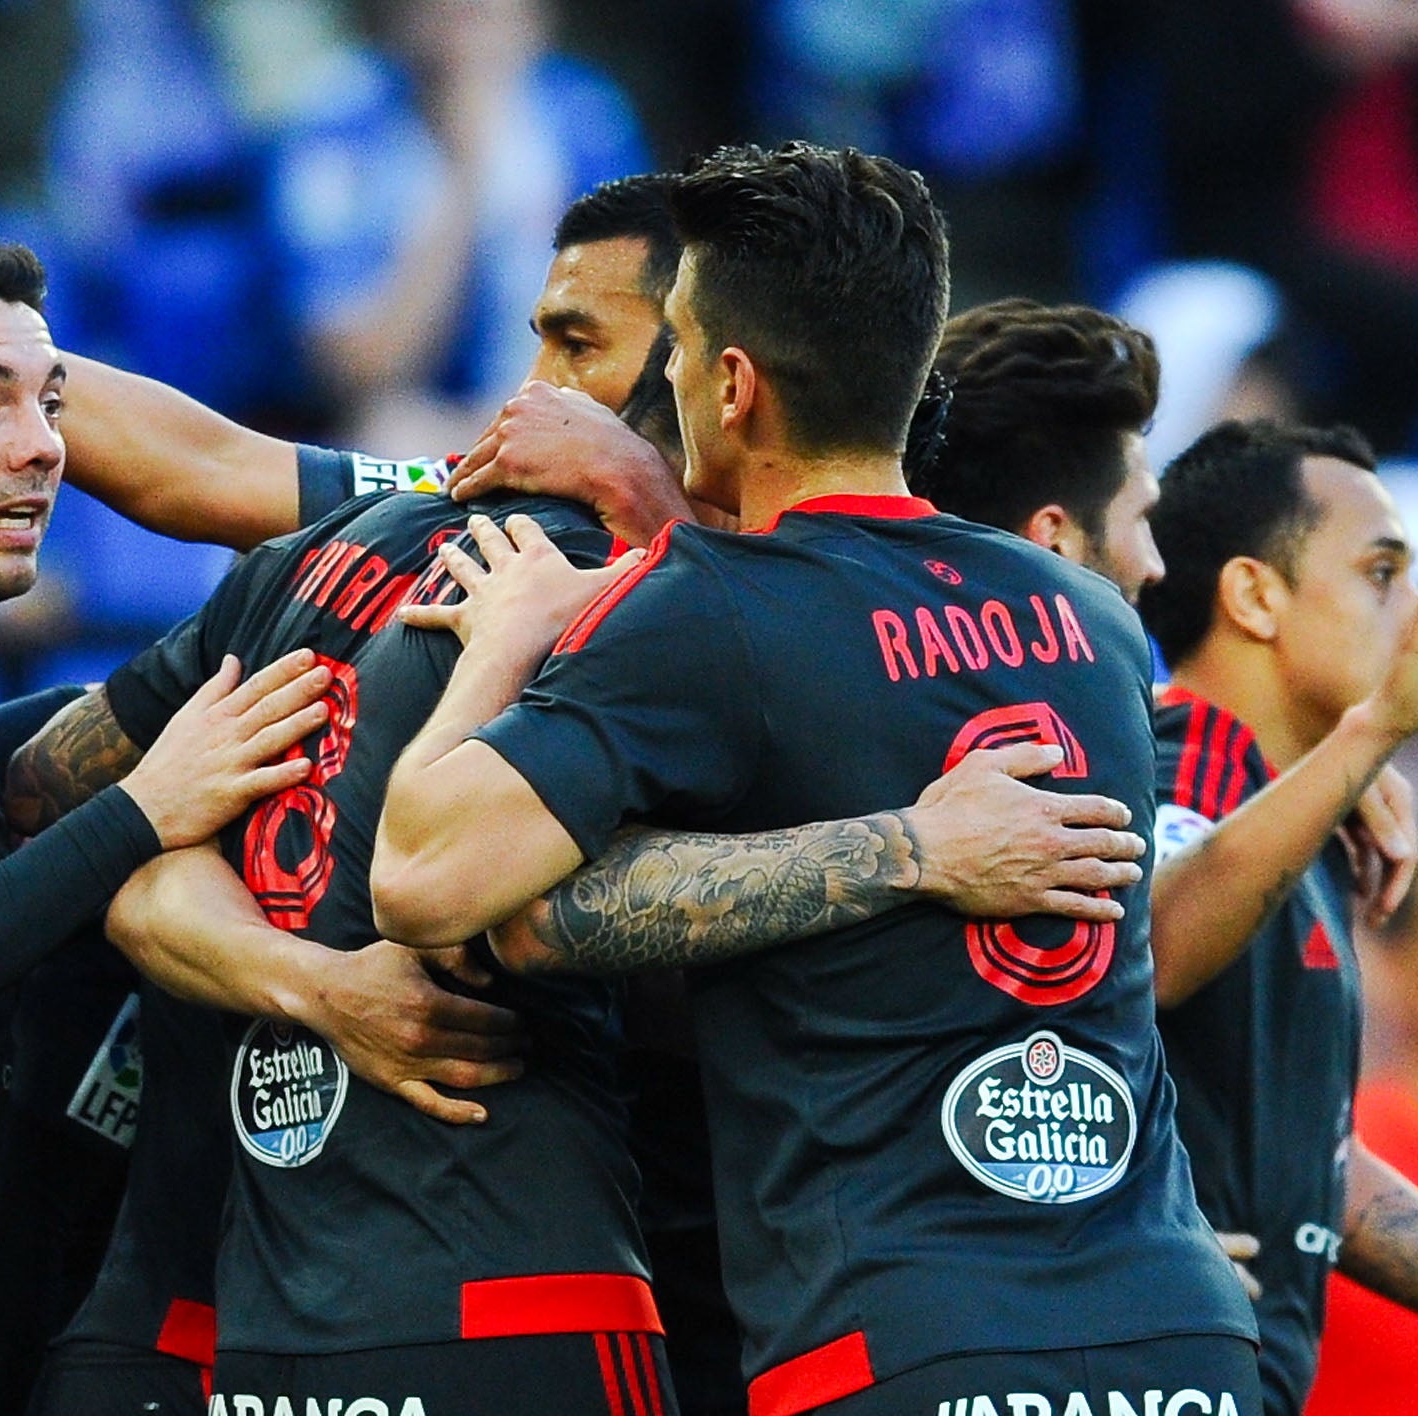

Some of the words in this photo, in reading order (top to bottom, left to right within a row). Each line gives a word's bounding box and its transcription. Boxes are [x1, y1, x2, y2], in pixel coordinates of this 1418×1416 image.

[872, 593, 1095, 683] RADOJA
[244, 654, 359, 930] 8
[976, 1076, 1114, 1124] Estrella
[985, 1118, 1109, 1166] Galicia
